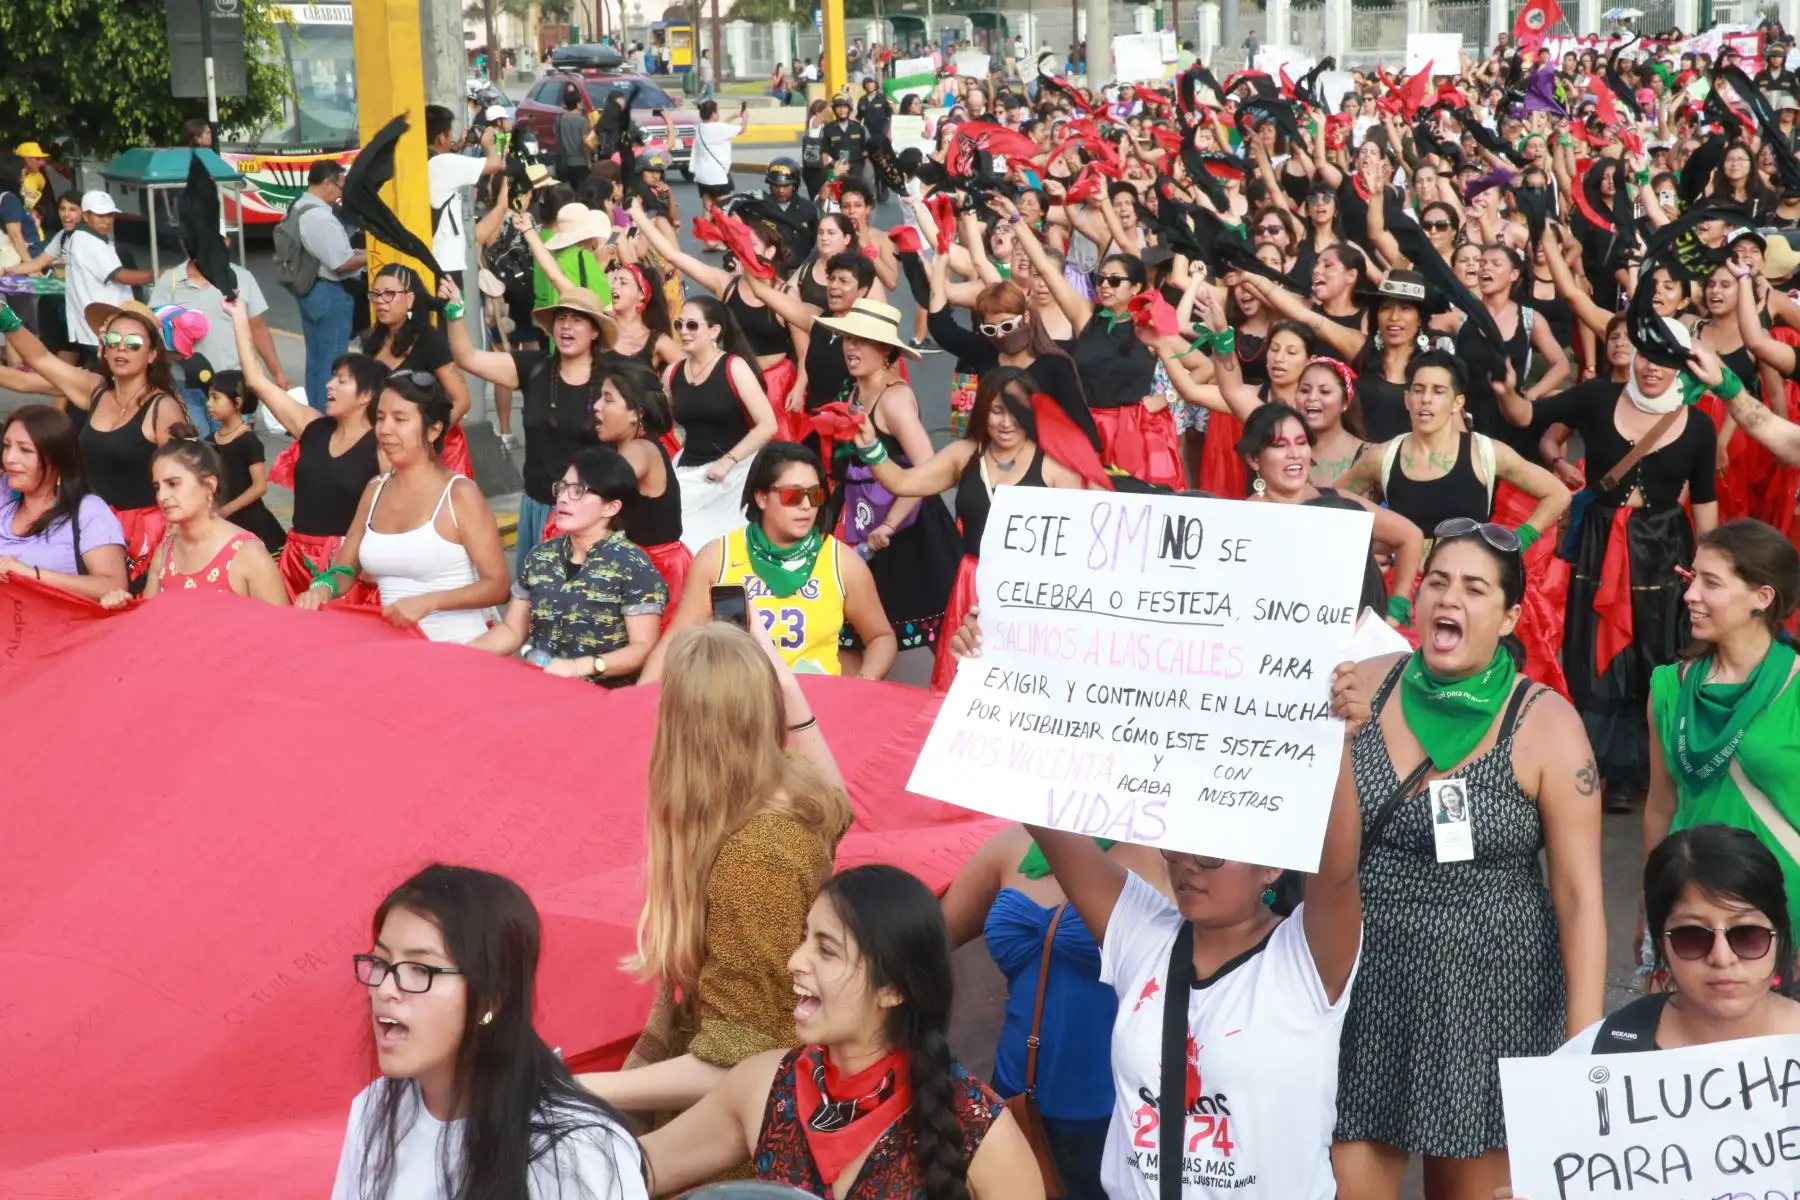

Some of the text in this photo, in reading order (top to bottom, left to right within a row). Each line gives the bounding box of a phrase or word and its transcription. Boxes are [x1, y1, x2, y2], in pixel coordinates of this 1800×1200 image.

[1003, 501, 1252, 574] ESTE 8M NO SE
[996, 580, 1355, 626] CELEBRA O FESTEJA, SINO QUE
[993, 619, 1314, 680] SALIMOS A LAS CALLES PARA
[983, 666, 1330, 722] EXIGIR Y CONTINUAR EN LA LUCHA
[948, 727, 1116, 786] NOS VIOLENTA
[966, 698, 1317, 762] POR VISIBILIZAR CÓMO ESTE SISTEMA
[1116, 774, 1284, 812] ACABA NUESTRAS
[1153, 753, 1253, 781] Y CON
[1046, 787, 1168, 842] VIDAS
[1610, 1030, 1638, 1040] OCEANO
[1131, 1104, 1234, 1157] 274
[1205, 1159, 1236, 1177] MAS
[1552, 1125, 1800, 1200] PARA QUE
